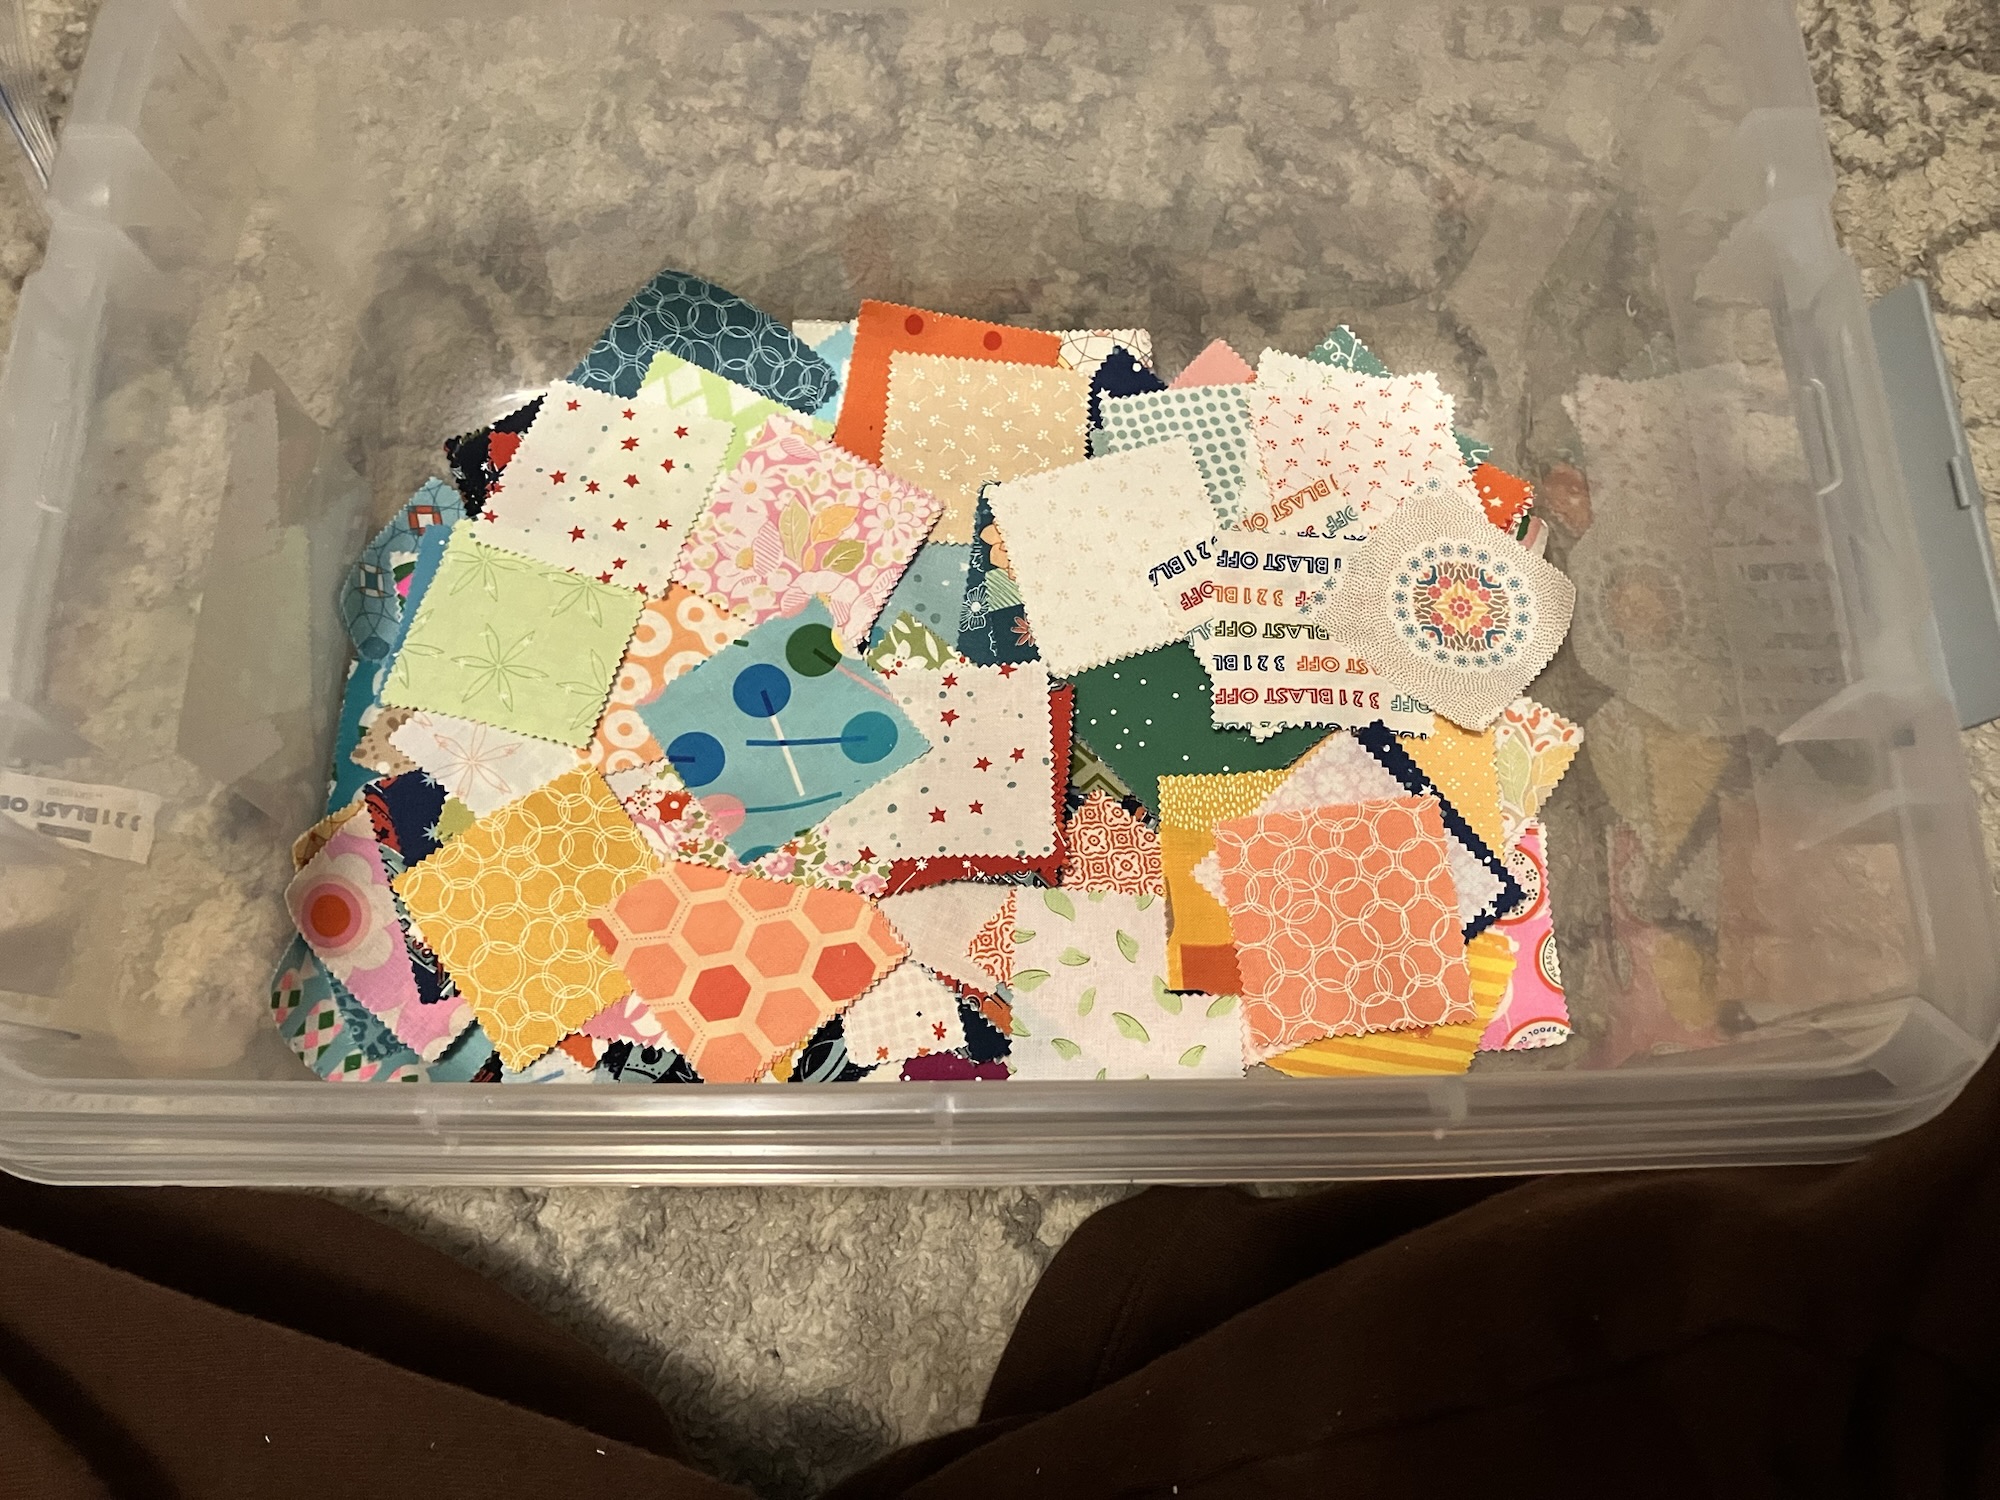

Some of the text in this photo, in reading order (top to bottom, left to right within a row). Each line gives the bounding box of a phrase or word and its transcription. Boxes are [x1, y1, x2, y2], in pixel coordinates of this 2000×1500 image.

[1270, 480, 1332, 522] BLAST
[1196, 543, 1212, 560] 2
[1216, 550, 1258, 570] OFF
[1264, 554, 1328, 574] BLAST
[1180, 581, 1214, 610] OFF
[1212, 586, 1283, 606] 3 2 1 BL
[1214, 621, 1329, 640] BLAST OFF
[1212, 655, 1285, 671] 3 2 1 BL
[1296, 656, 1380, 675] ST OFF
[1216, 688, 1380, 709] 3 2 1 BLAST OFF
[1528, 1026, 1557, 1037] SPOOL
